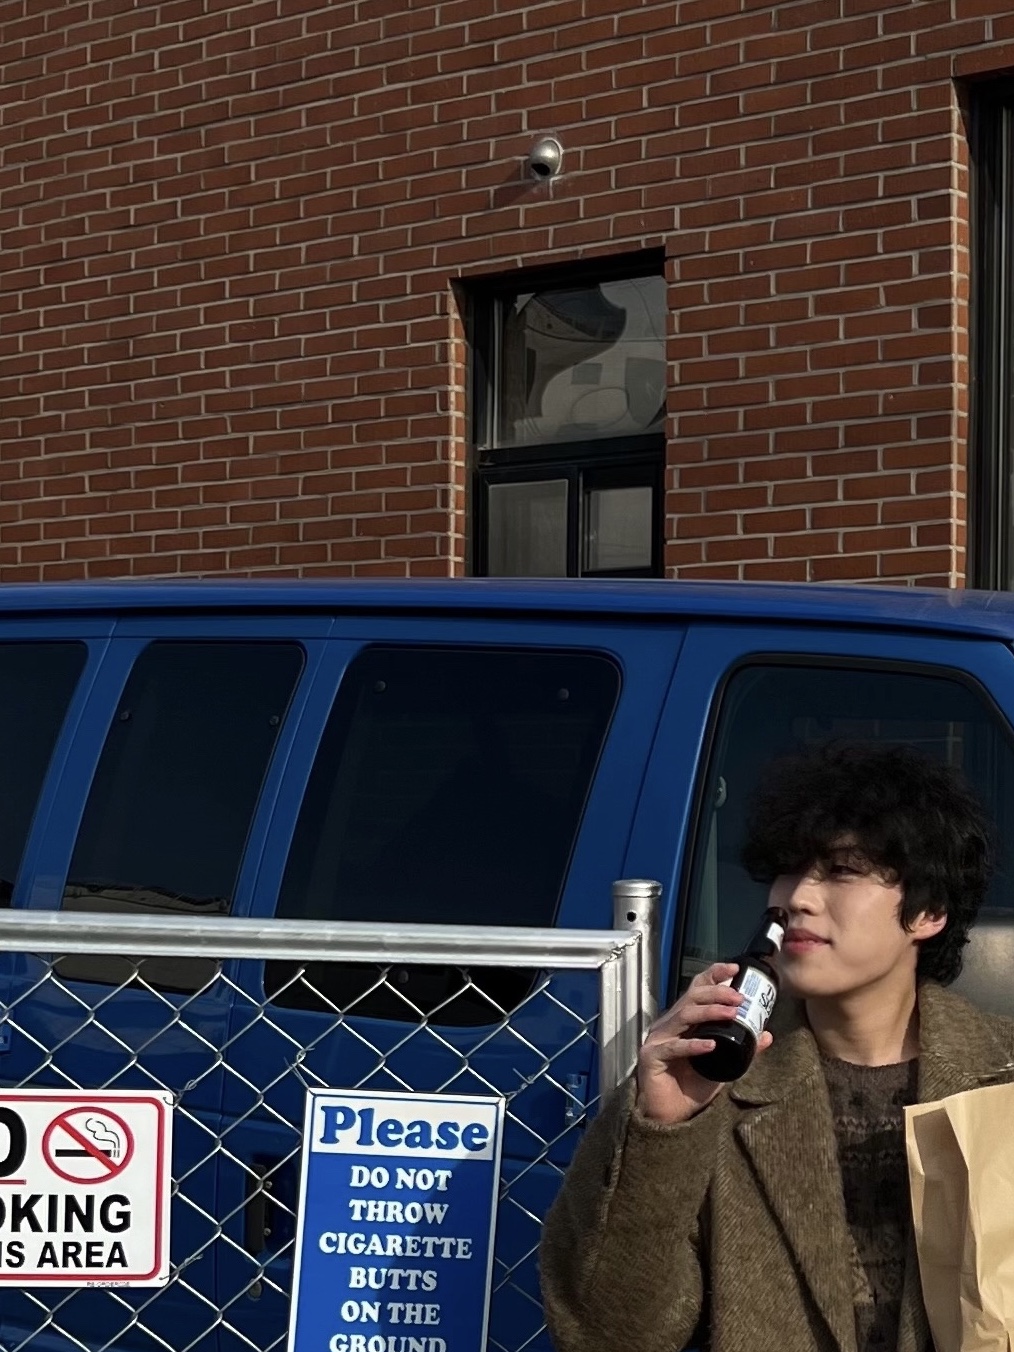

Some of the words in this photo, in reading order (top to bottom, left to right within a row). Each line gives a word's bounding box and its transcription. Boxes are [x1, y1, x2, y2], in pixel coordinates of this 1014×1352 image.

[319, 1105, 490, 1152] Please
[349, 1165, 388, 1189] DO
[395, 1167, 453, 1191] NOT
[0, 1193, 132, 1234] KING
[349, 1199, 449, 1225] THROW
[37, 1241, 129, 1269] AREA
[318, 1232, 473, 1260] CIGARETTE
[349, 1266, 438, 1291] BUTTS
[340, 1300, 383, 1324] ON
[387, 1301, 441, 1326] THE
